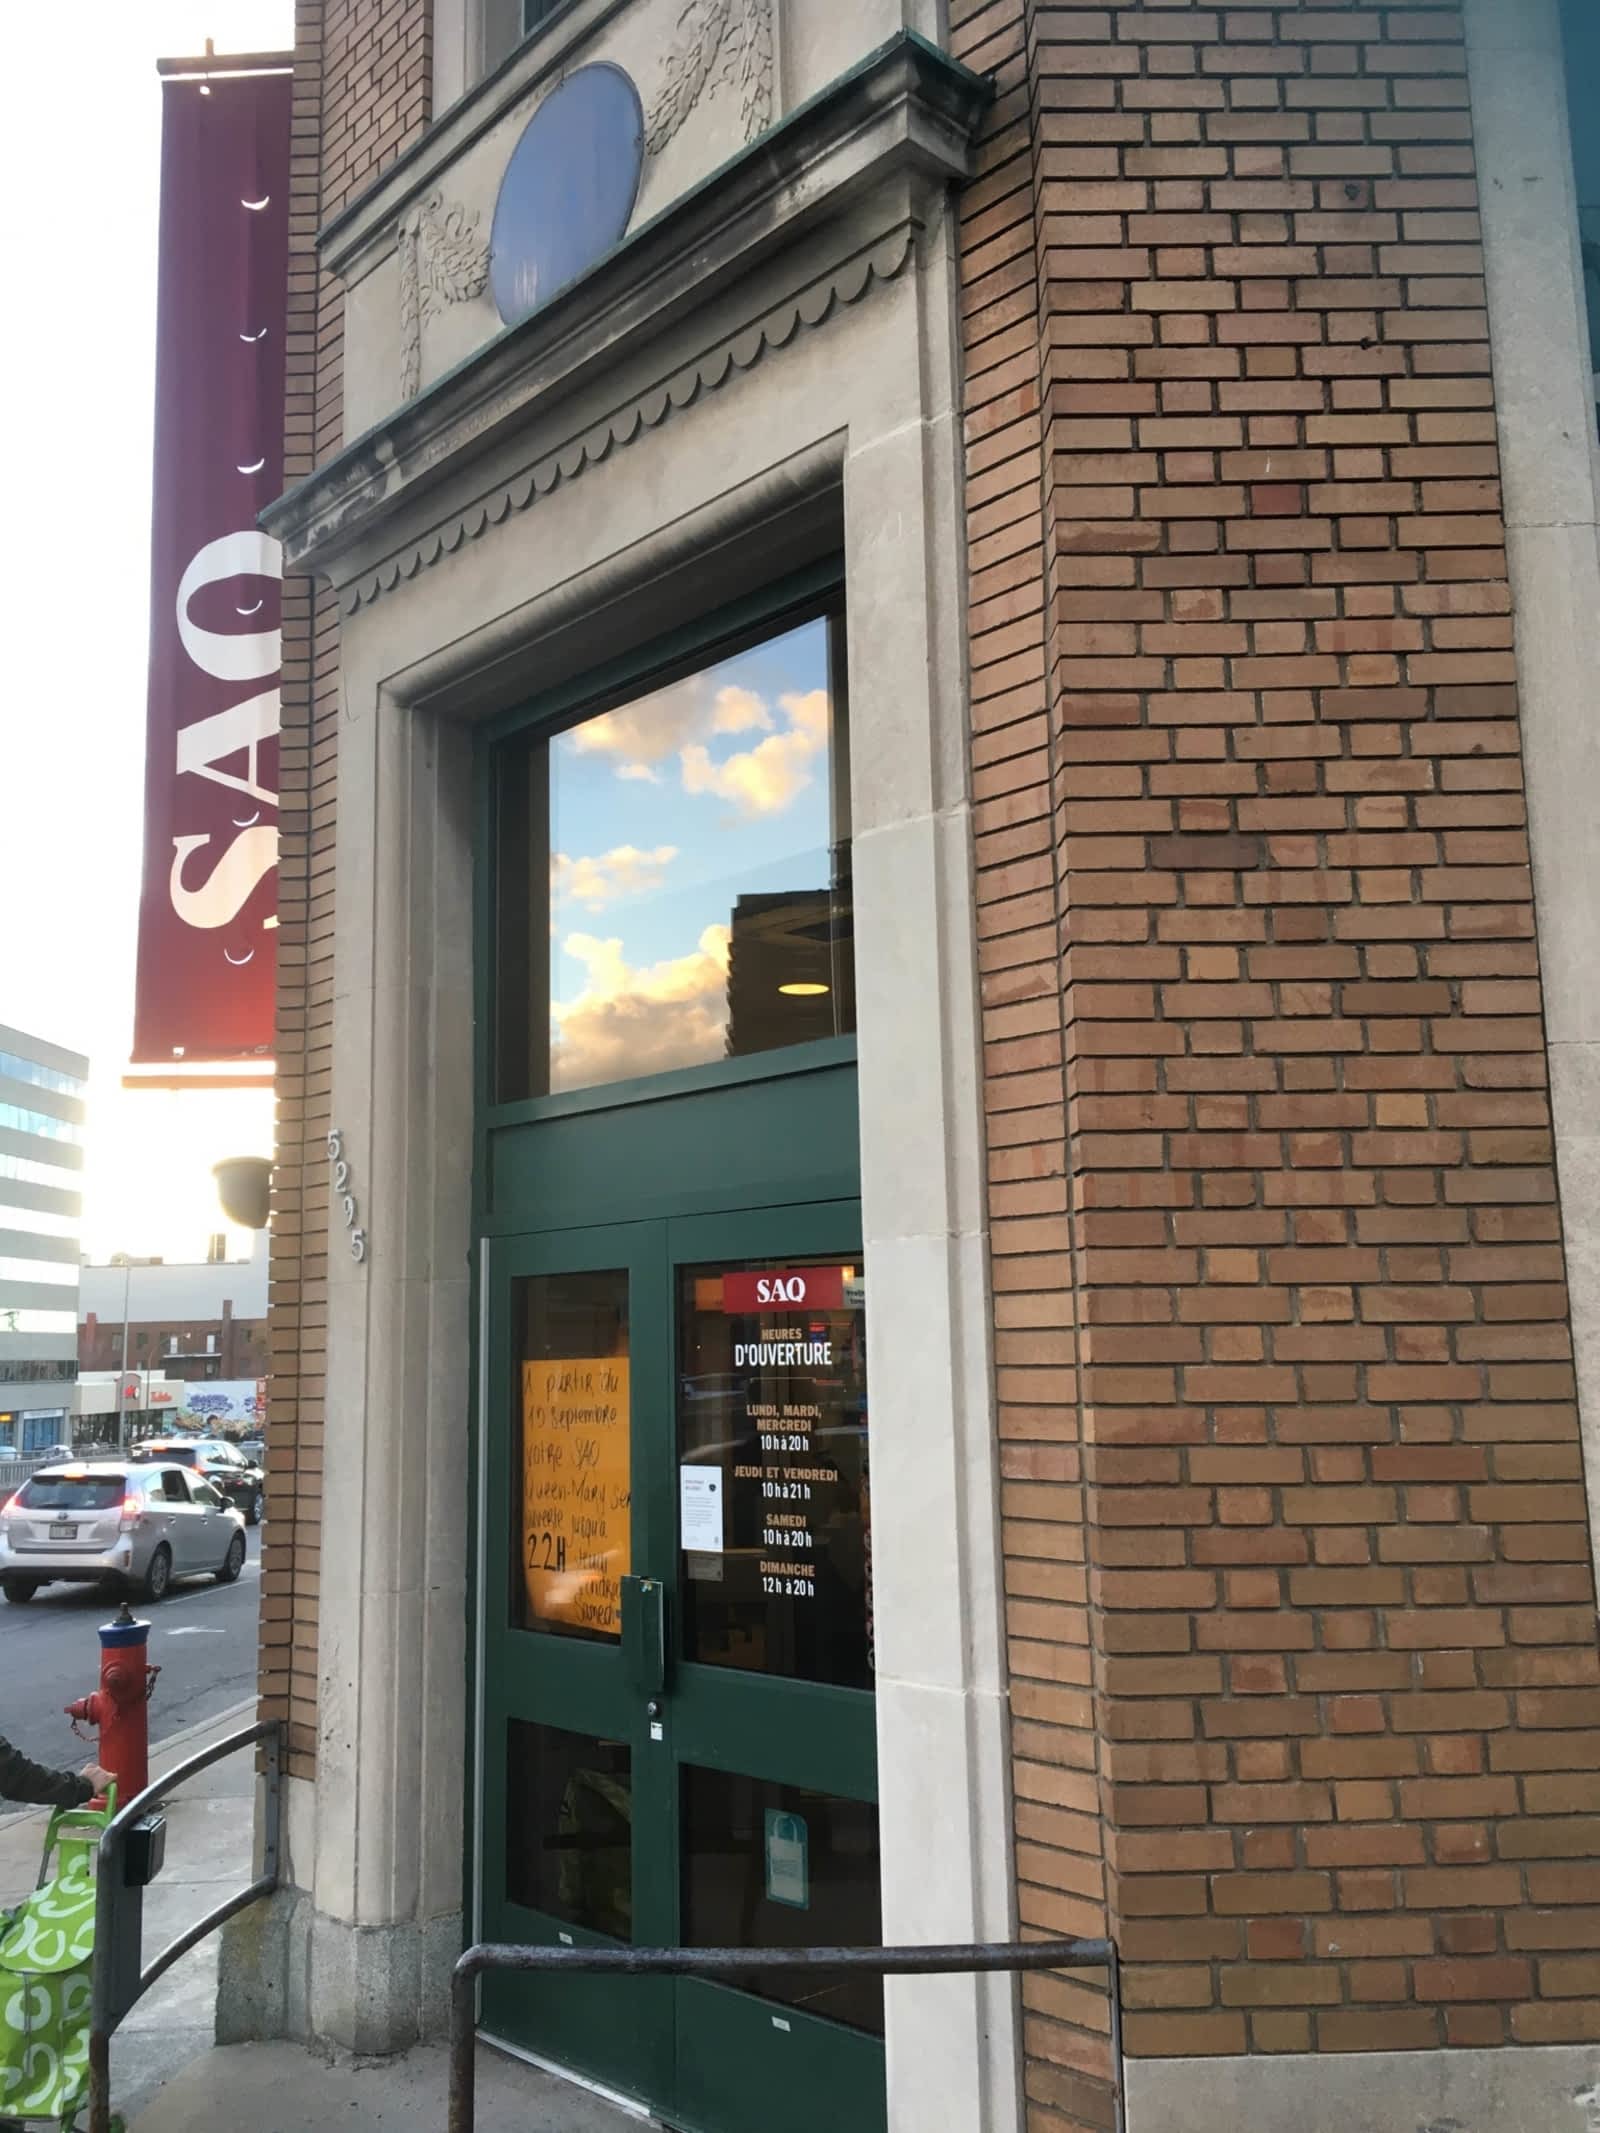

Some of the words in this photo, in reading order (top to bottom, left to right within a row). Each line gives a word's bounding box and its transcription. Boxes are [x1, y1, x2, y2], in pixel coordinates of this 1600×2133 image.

[327, 1129, 365, 1264] 5295
[757, 1277, 807, 1303] SAQ
[761, 1328, 803, 1341] HEURES
[735, 1342, 833, 1367] D'OUVERTURE
[746, 1404, 780, 1418] LUNDI,
[784, 1404, 822, 1419] MARDI,
[756, 1418, 812, 1432] MERCREDI
[735, 1465, 763, 1478] JEUDI
[766, 1467, 780, 1479] ET
[784, 1468, 838, 1482] VENDREDI
[766, 1513, 807, 1528] SAMEDI
[528, 1532, 566, 1573] 22H
[760, 1560, 816, 1577] DIMANCHE
